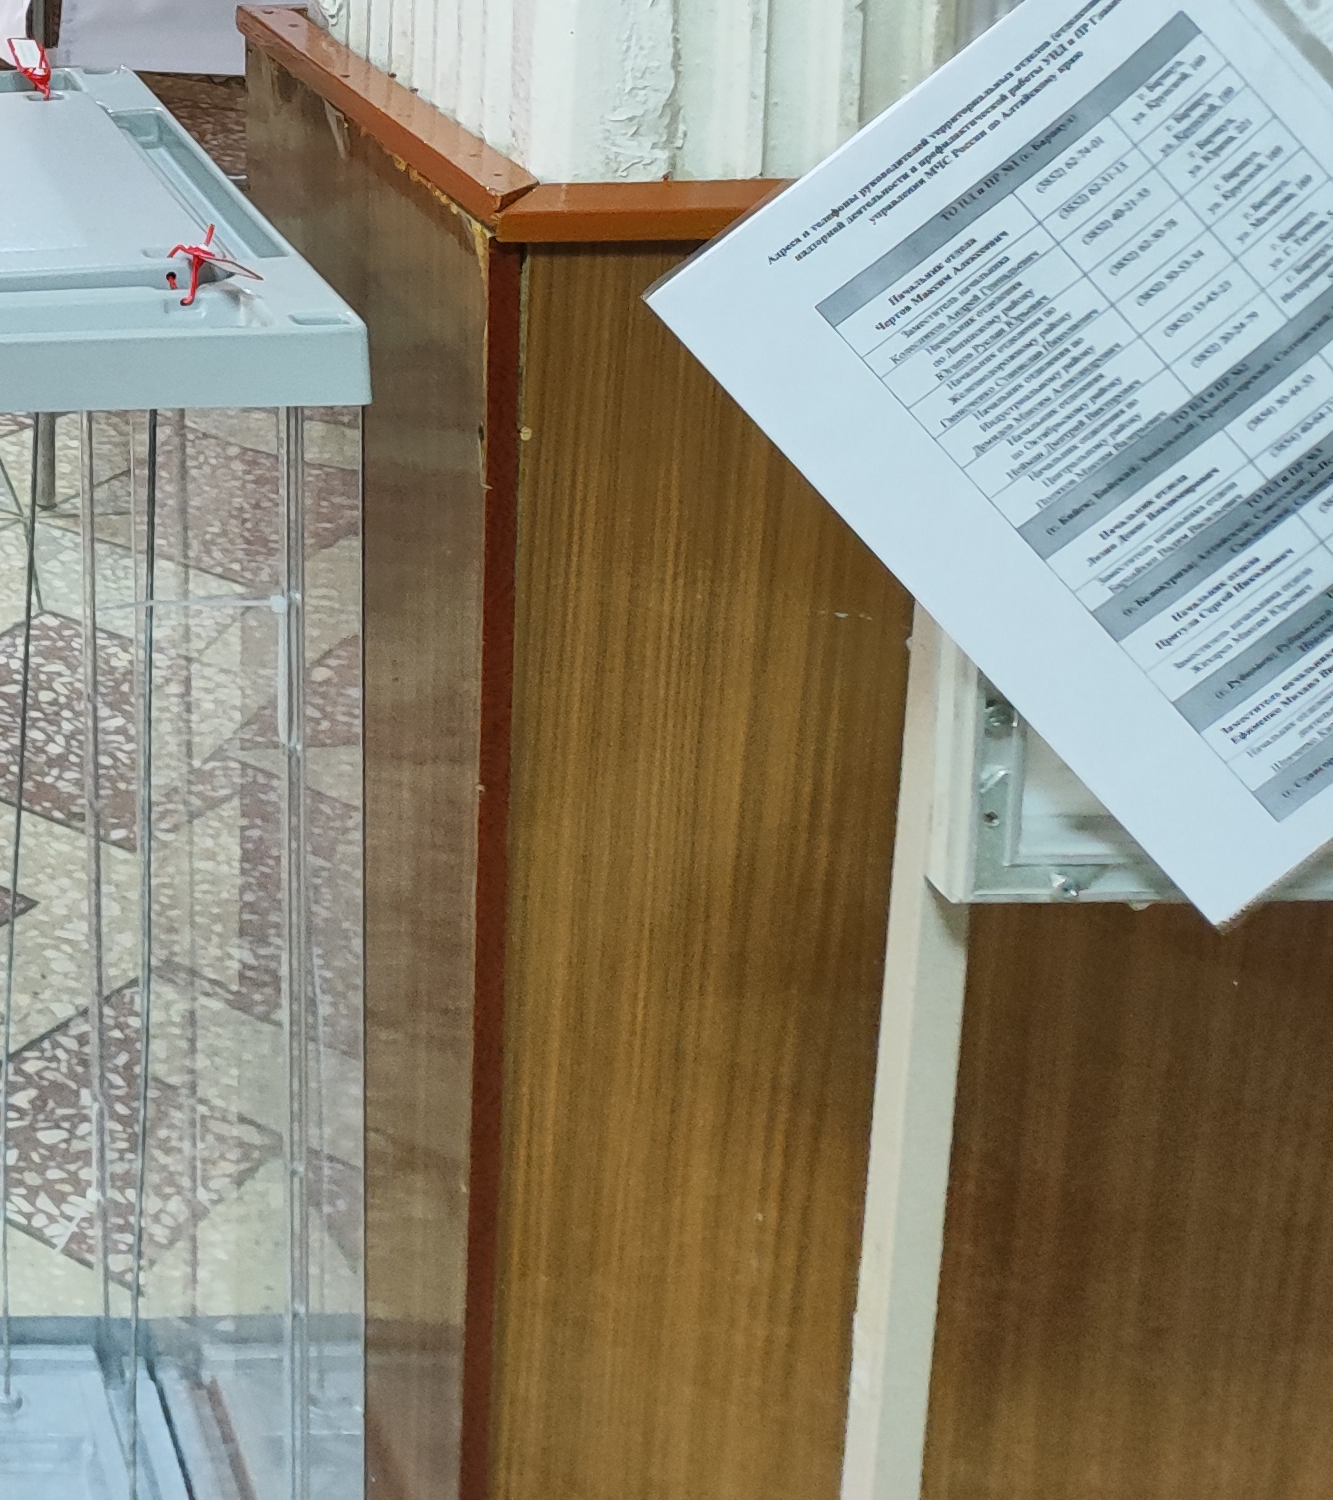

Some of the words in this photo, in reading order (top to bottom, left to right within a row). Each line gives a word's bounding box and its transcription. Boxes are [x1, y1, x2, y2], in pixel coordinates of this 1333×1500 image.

[923, 155, 952, 179] МЧС
[950, 128, 988, 158] России
[1000, 71, 1057, 120] Алтайскому
[810, 193, 859, 232] телефоны
[857, 138, 930, 196] руководителей
[910, 272, 952, 306] Максим
